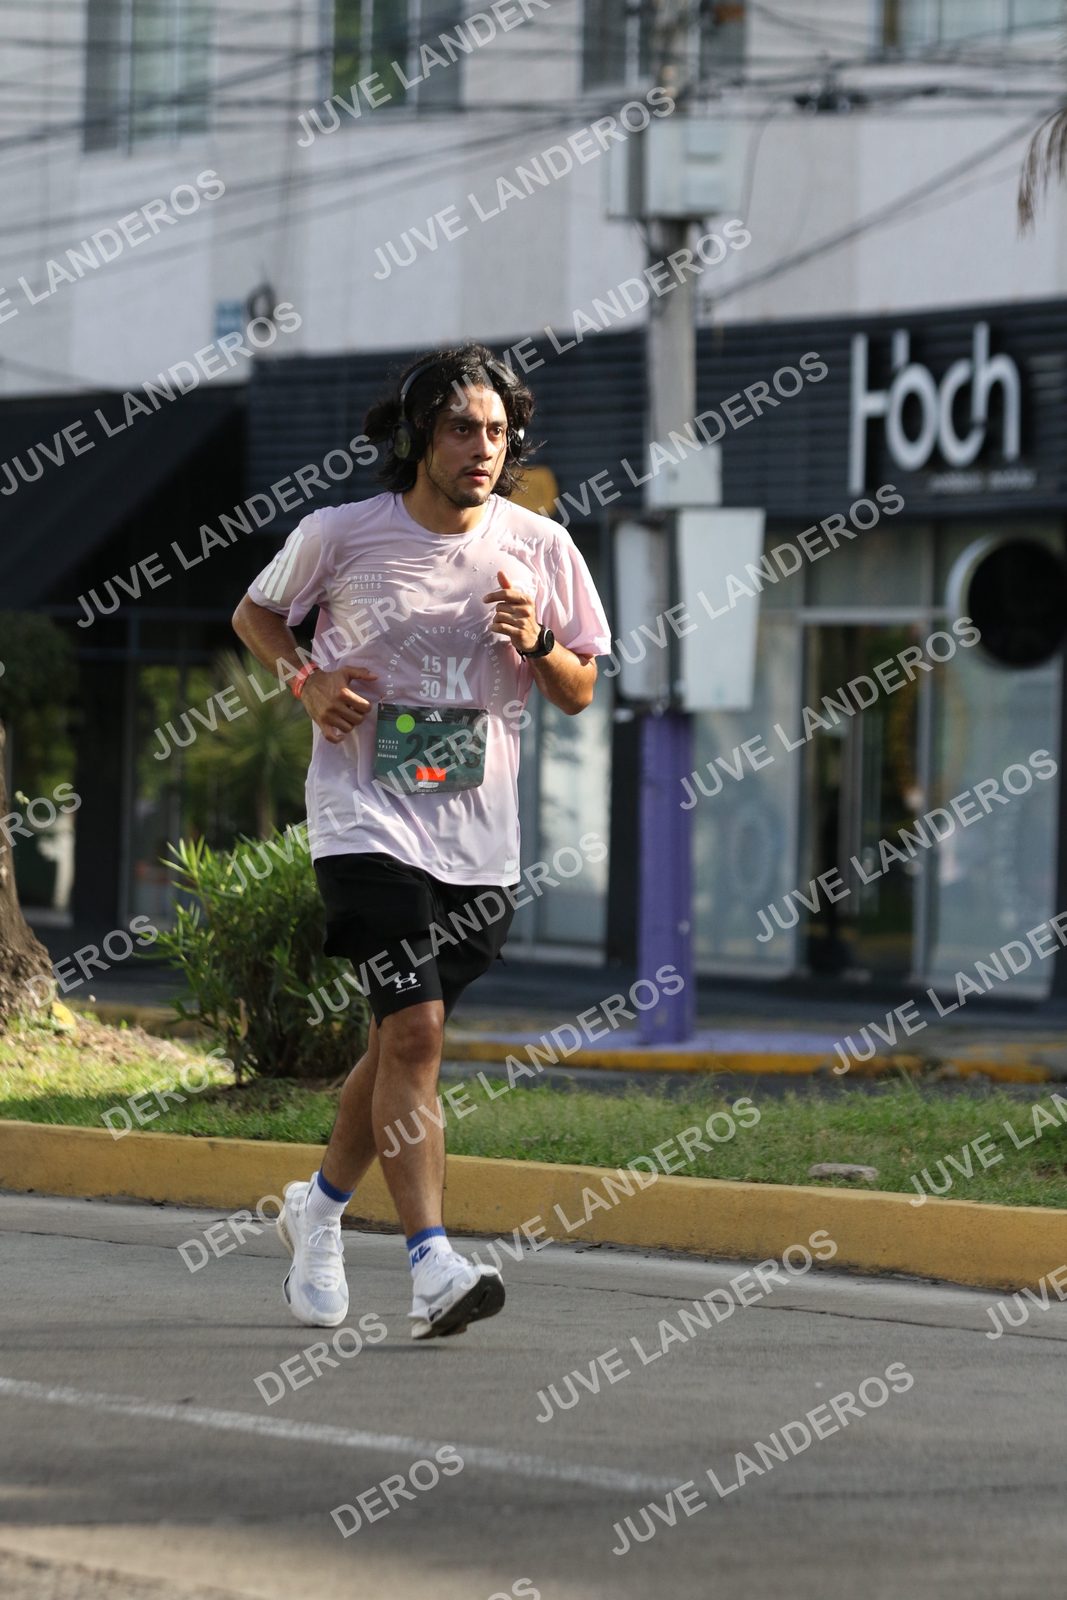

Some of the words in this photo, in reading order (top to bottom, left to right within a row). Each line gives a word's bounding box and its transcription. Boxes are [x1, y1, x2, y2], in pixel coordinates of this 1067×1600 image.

[421, 655, 441, 673] 15
[446, 656, 473, 700] K
[420, 680, 441, 698] 30
